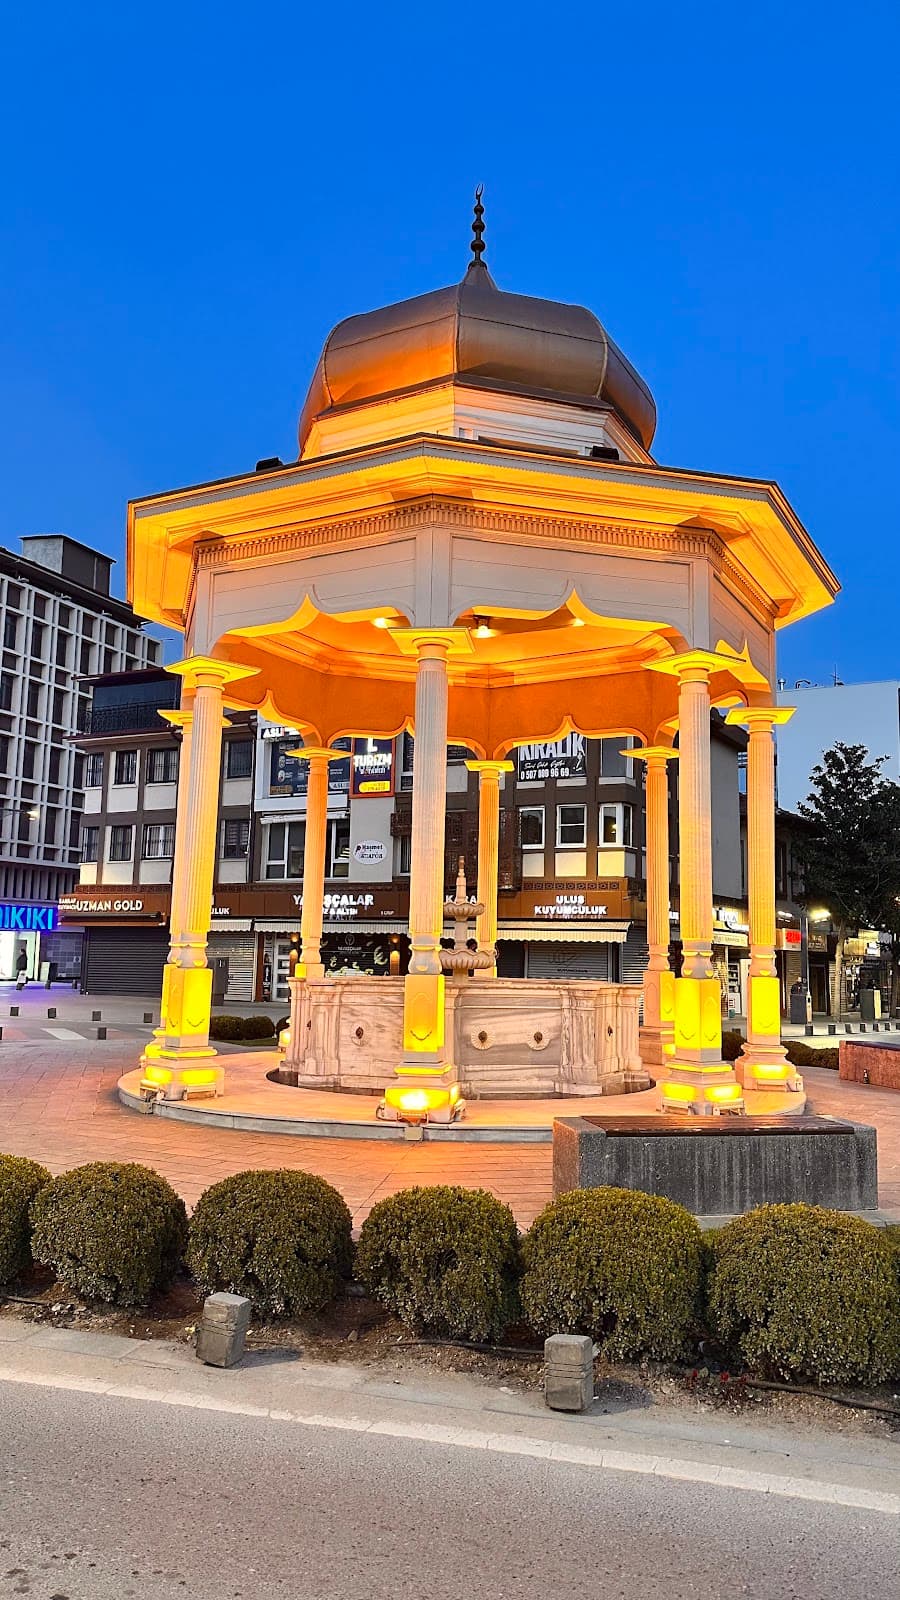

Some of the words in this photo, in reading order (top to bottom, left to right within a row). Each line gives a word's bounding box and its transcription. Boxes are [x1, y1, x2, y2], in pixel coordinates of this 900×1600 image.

[520, 732, 586, 761] KIRALIK
[556, 895, 585, 904] ULUS
[76, 901, 112, 912] UZMAN
[113, 900, 143, 911] GOLD
[534, 906, 607, 915] KUYUMCULUK
